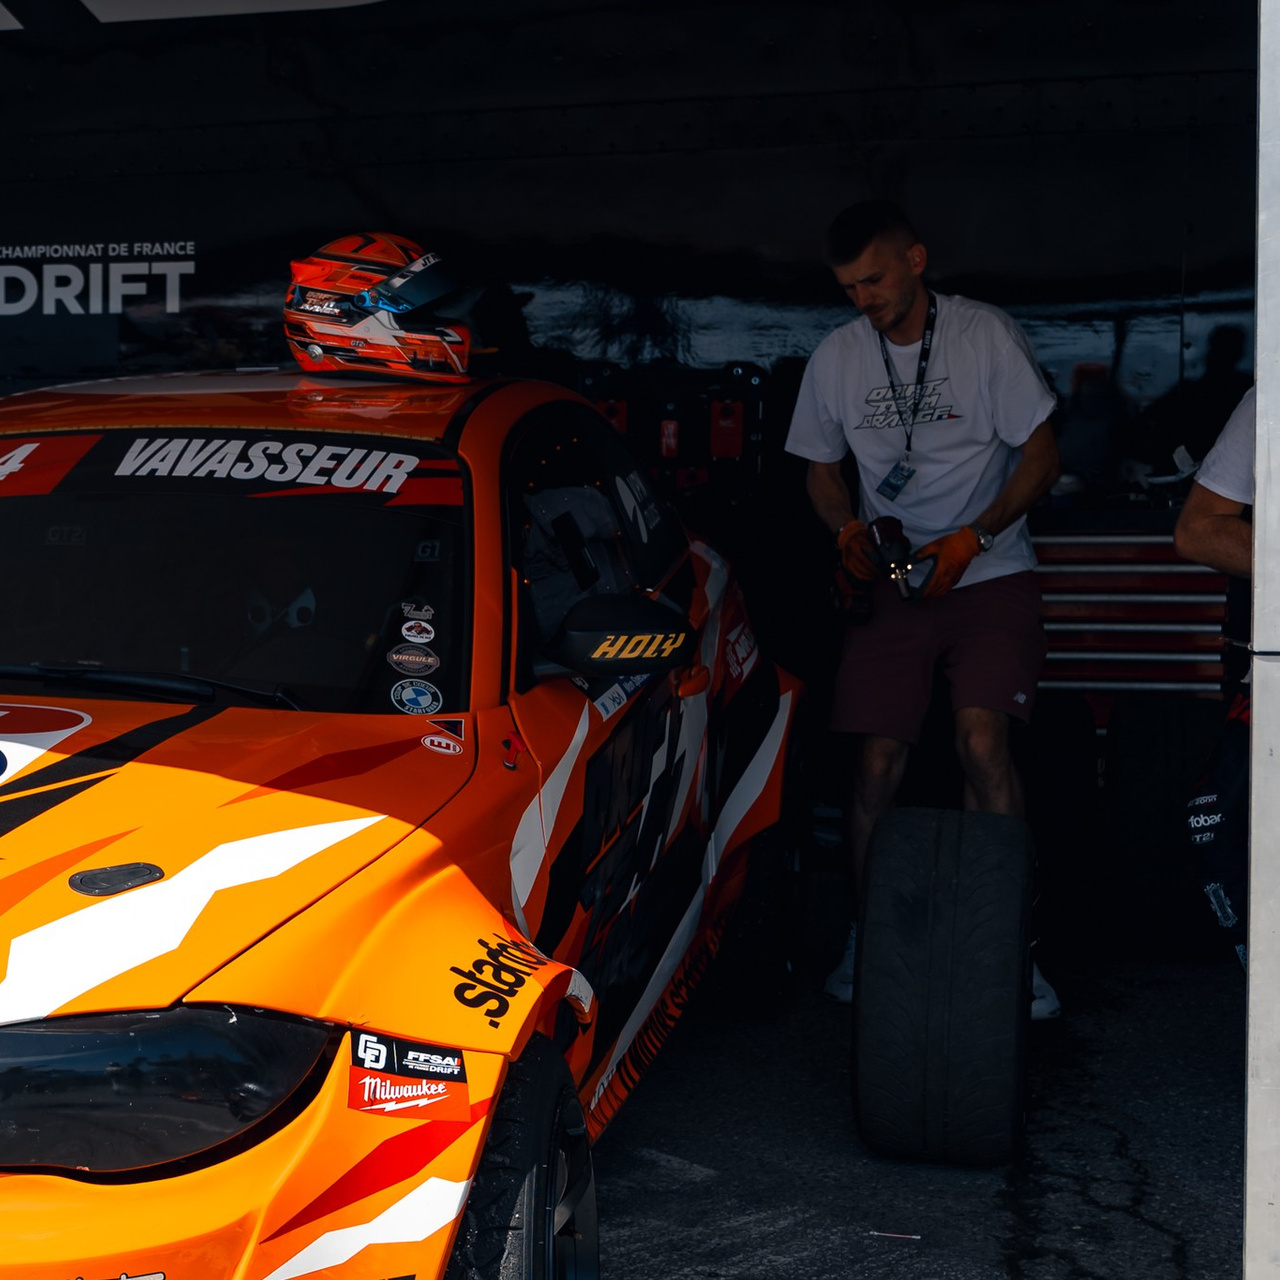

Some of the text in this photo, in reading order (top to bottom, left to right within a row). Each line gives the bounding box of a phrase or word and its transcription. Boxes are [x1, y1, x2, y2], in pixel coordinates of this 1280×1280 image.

[108, 243, 129, 257] DE
[133, 241, 195, 256] FRANCE
[114, 437, 419, 494] VAVASSEUR
[591, 632, 686, 659] HOLY
[392, 654, 436, 663] VIRGULE
[407, 1050, 458, 1066] FFSA
[429, 1065, 461, 1075] DRIFT
[358, 1075, 447, 1102] Milwaukee
